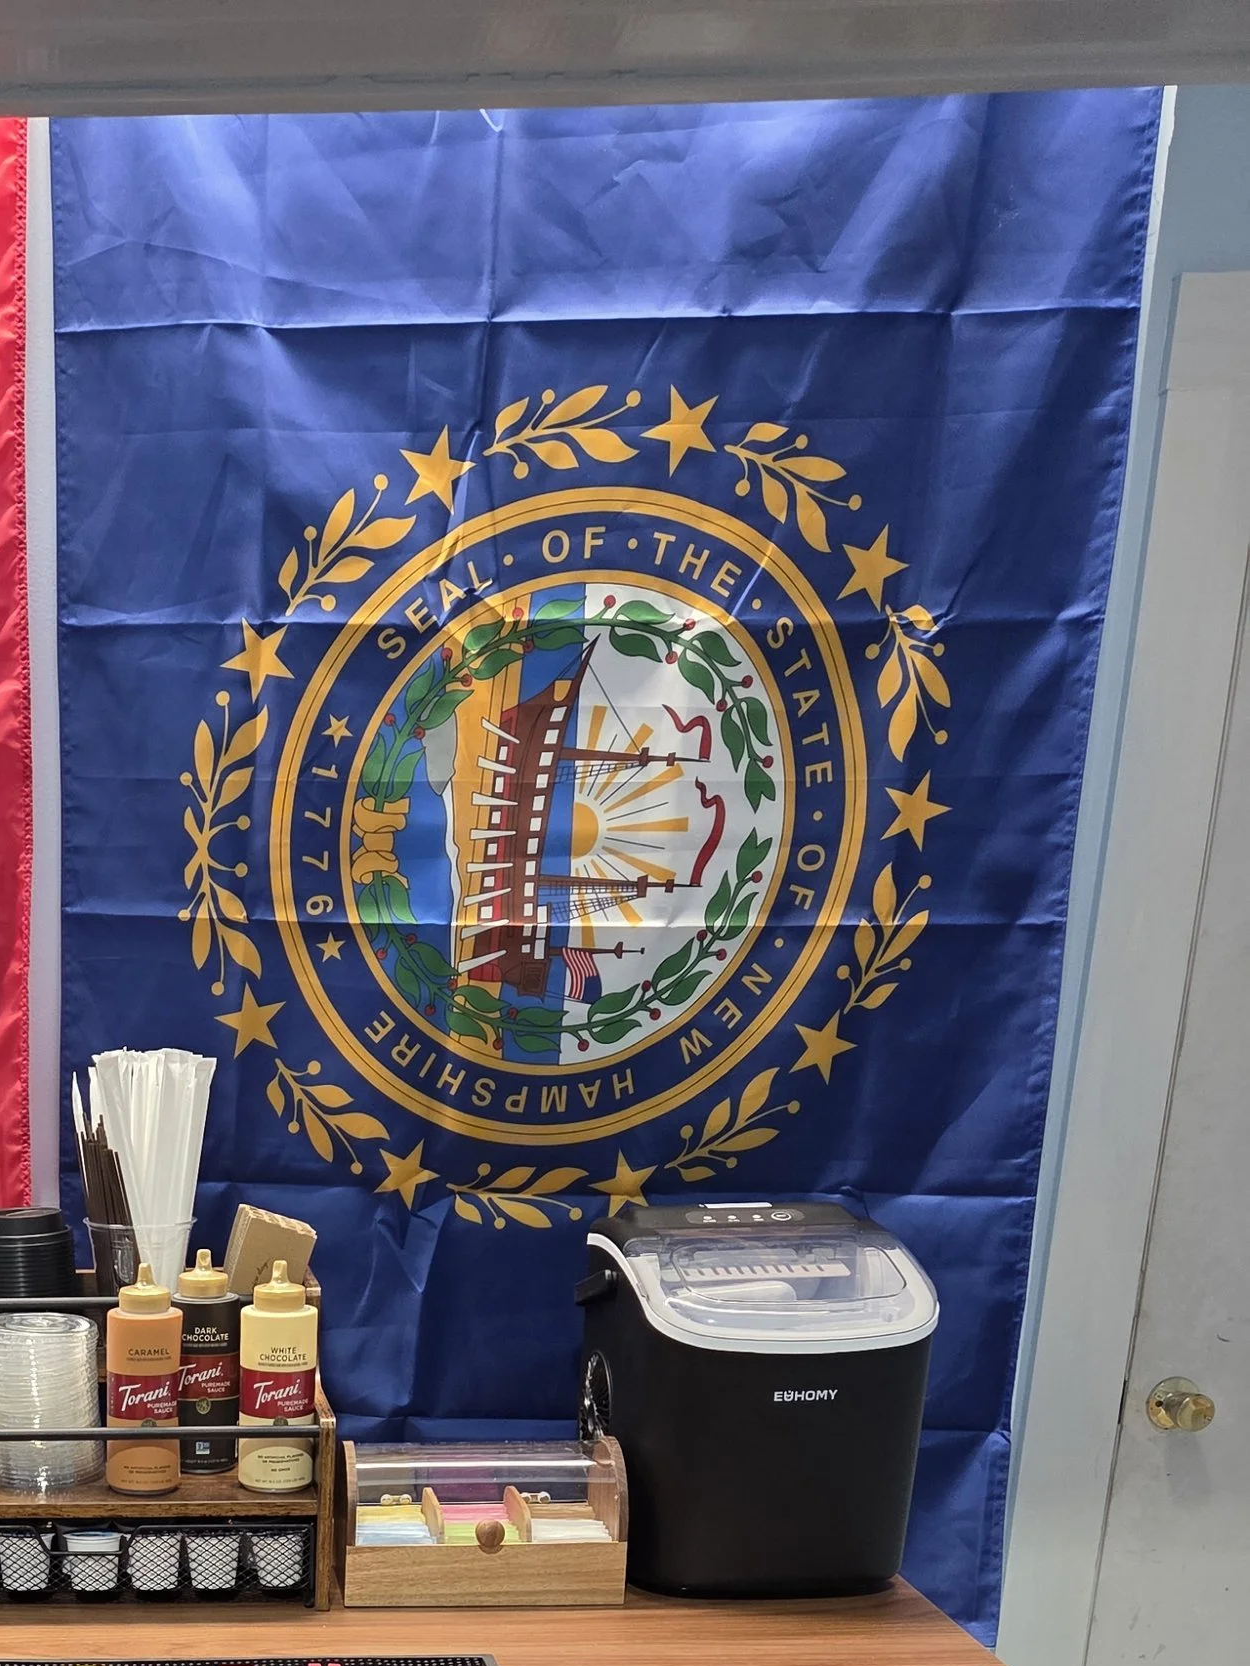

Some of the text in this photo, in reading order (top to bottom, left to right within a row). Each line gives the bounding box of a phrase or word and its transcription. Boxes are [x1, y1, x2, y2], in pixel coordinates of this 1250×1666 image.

[363, 526, 833, 1114] SEAL OF THE STATE OF NEW HAMPSHIRE
[302, 763, 340, 917] 1776
[195, 1327, 217, 1335] DARK
[181, 1332, 229, 1342] CHOCOLATE
[128, 1348, 170, 1356] CARAMEL
[270, 1346, 297, 1354] WHITE
[259, 1353, 307, 1362] CHOCOLATE
[178, 1362, 222, 1391] Torani
[201, 1381, 231, 1389] PUREMADE
[118, 1382, 169, 1412] Torani
[253, 1379, 301, 1410] Torani
[773, 1388, 839, 1402] EUHOMY
[147, 1399, 177, 1409] PUREMADE
[277, 1399, 308, 1407] PUREMADE
